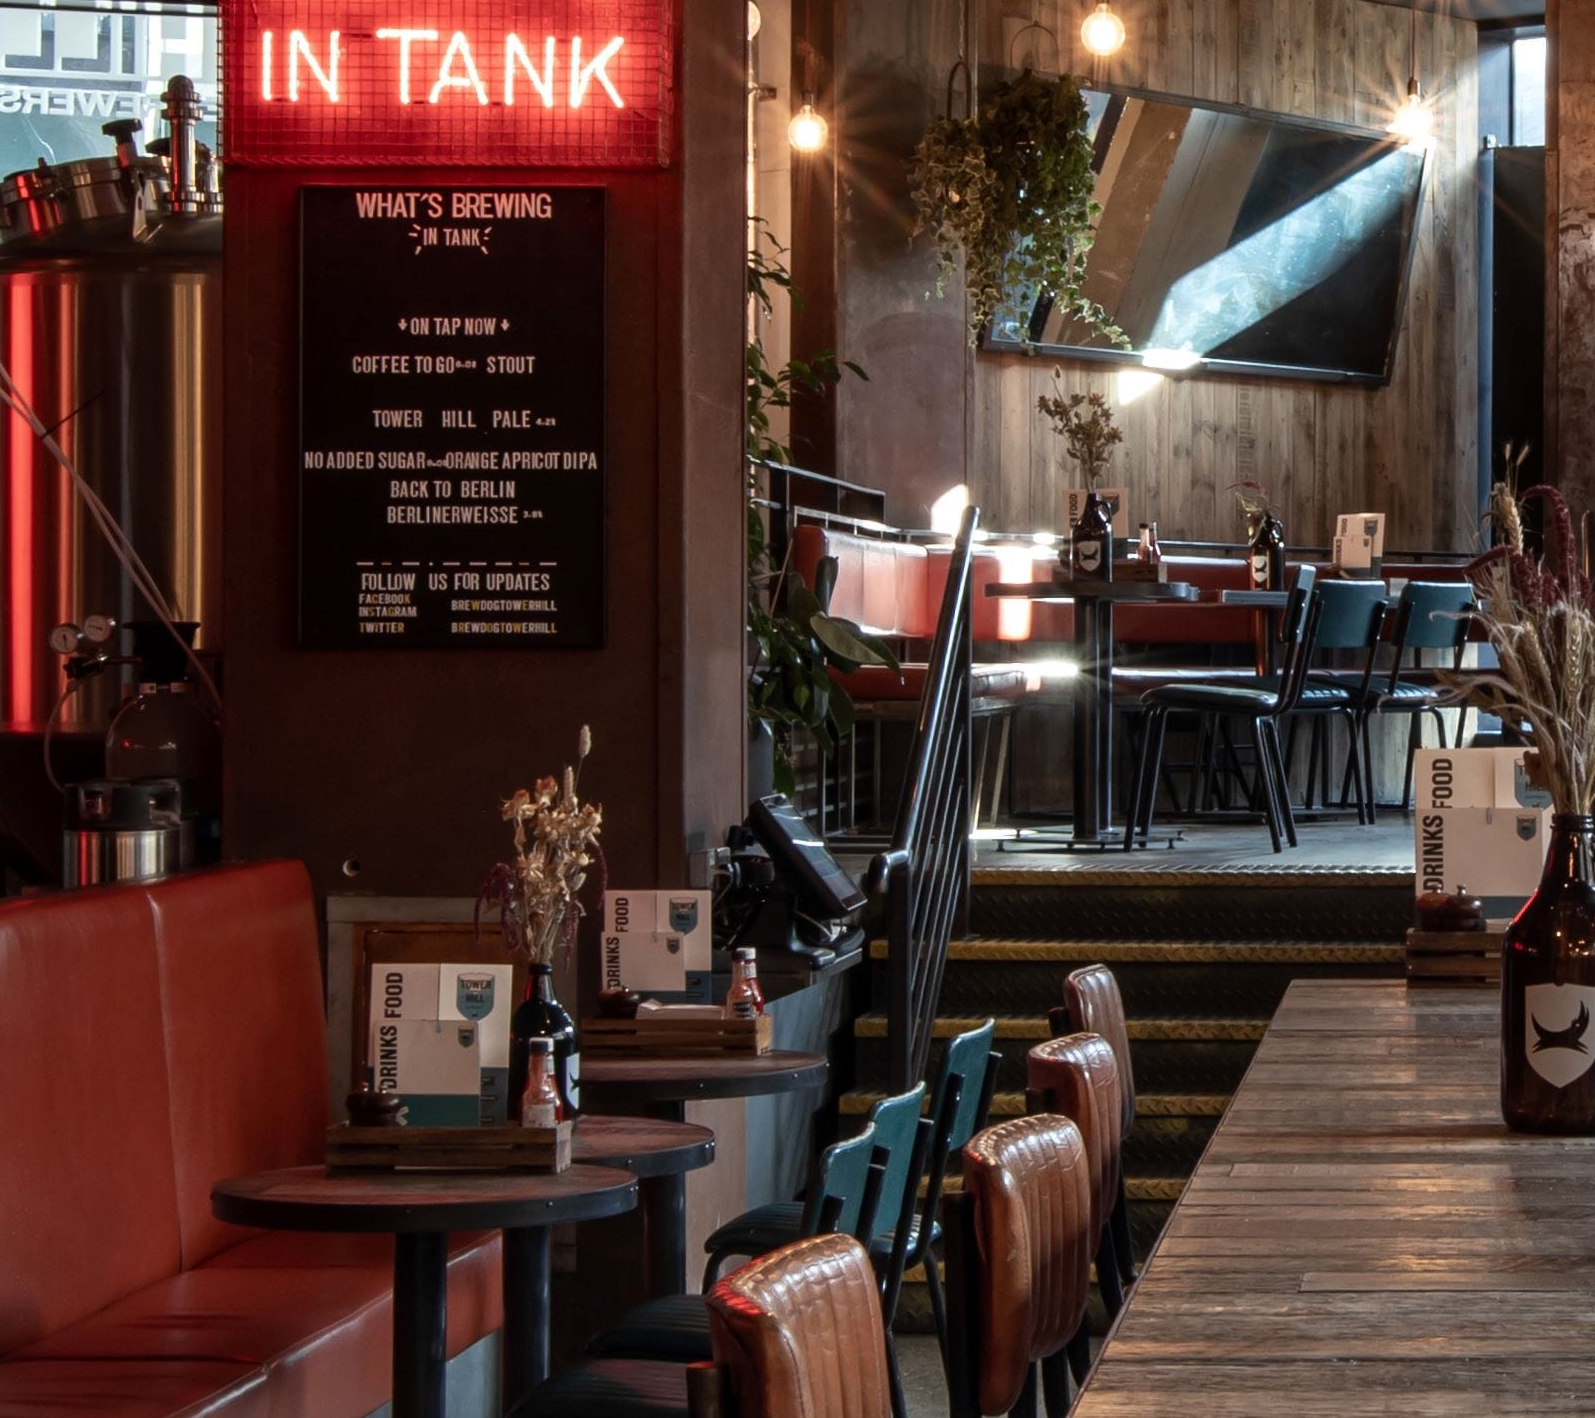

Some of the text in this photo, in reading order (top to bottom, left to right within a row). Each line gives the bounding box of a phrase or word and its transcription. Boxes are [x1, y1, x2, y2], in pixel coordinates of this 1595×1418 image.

[261, 27, 625, 110] IN TANK
[356, 193, 553, 219] WHAT'S BREWING
[423, 228, 480, 246] IN TANK
[410, 318, 496, 335] ON TAP NOW
[352, 356, 410, 374] COFFEE
[414, 356, 433, 374] TO
[435, 356, 455, 374] GO
[486, 356, 536, 374] STOUT
[372, 410, 423, 428] TOWER
[441, 410, 477, 428] HILL
[493, 410, 531, 428] PALE
[304, 452, 323, 470] NO
[326, 452, 374, 470] ADDED
[377, 452, 426, 470] SUGAR
[445, 452, 498, 470] ORANGE
[502, 452, 560, 470] APRICOT
[563, 452, 598, 470] DIPA
[390, 480, 515, 498] BACK TO BERLIN
[387, 506, 518, 524] BERLINERWEISSE
[361, 573, 550, 591] FOLLOW US FOR UPDATES
[359, 594, 411, 604] FACEBOOK
[451, 600, 557, 611] BREWDOGTOWERHILL
[358, 607, 417, 617] INSTAGRAM
[359, 622, 405, 633] TWITTER
[451, 622, 557, 633] BREWDOGTOWERHILL
[1432, 758, 1453, 809] FOOD
[1422, 815, 1444, 894] DRINKS
[615, 897, 629, 933] FOOD
[606, 937, 620, 989] DRINKS
[384, 972, 403, 1018] FOOD
[380, 1025, 397, 1090] DRINKS
